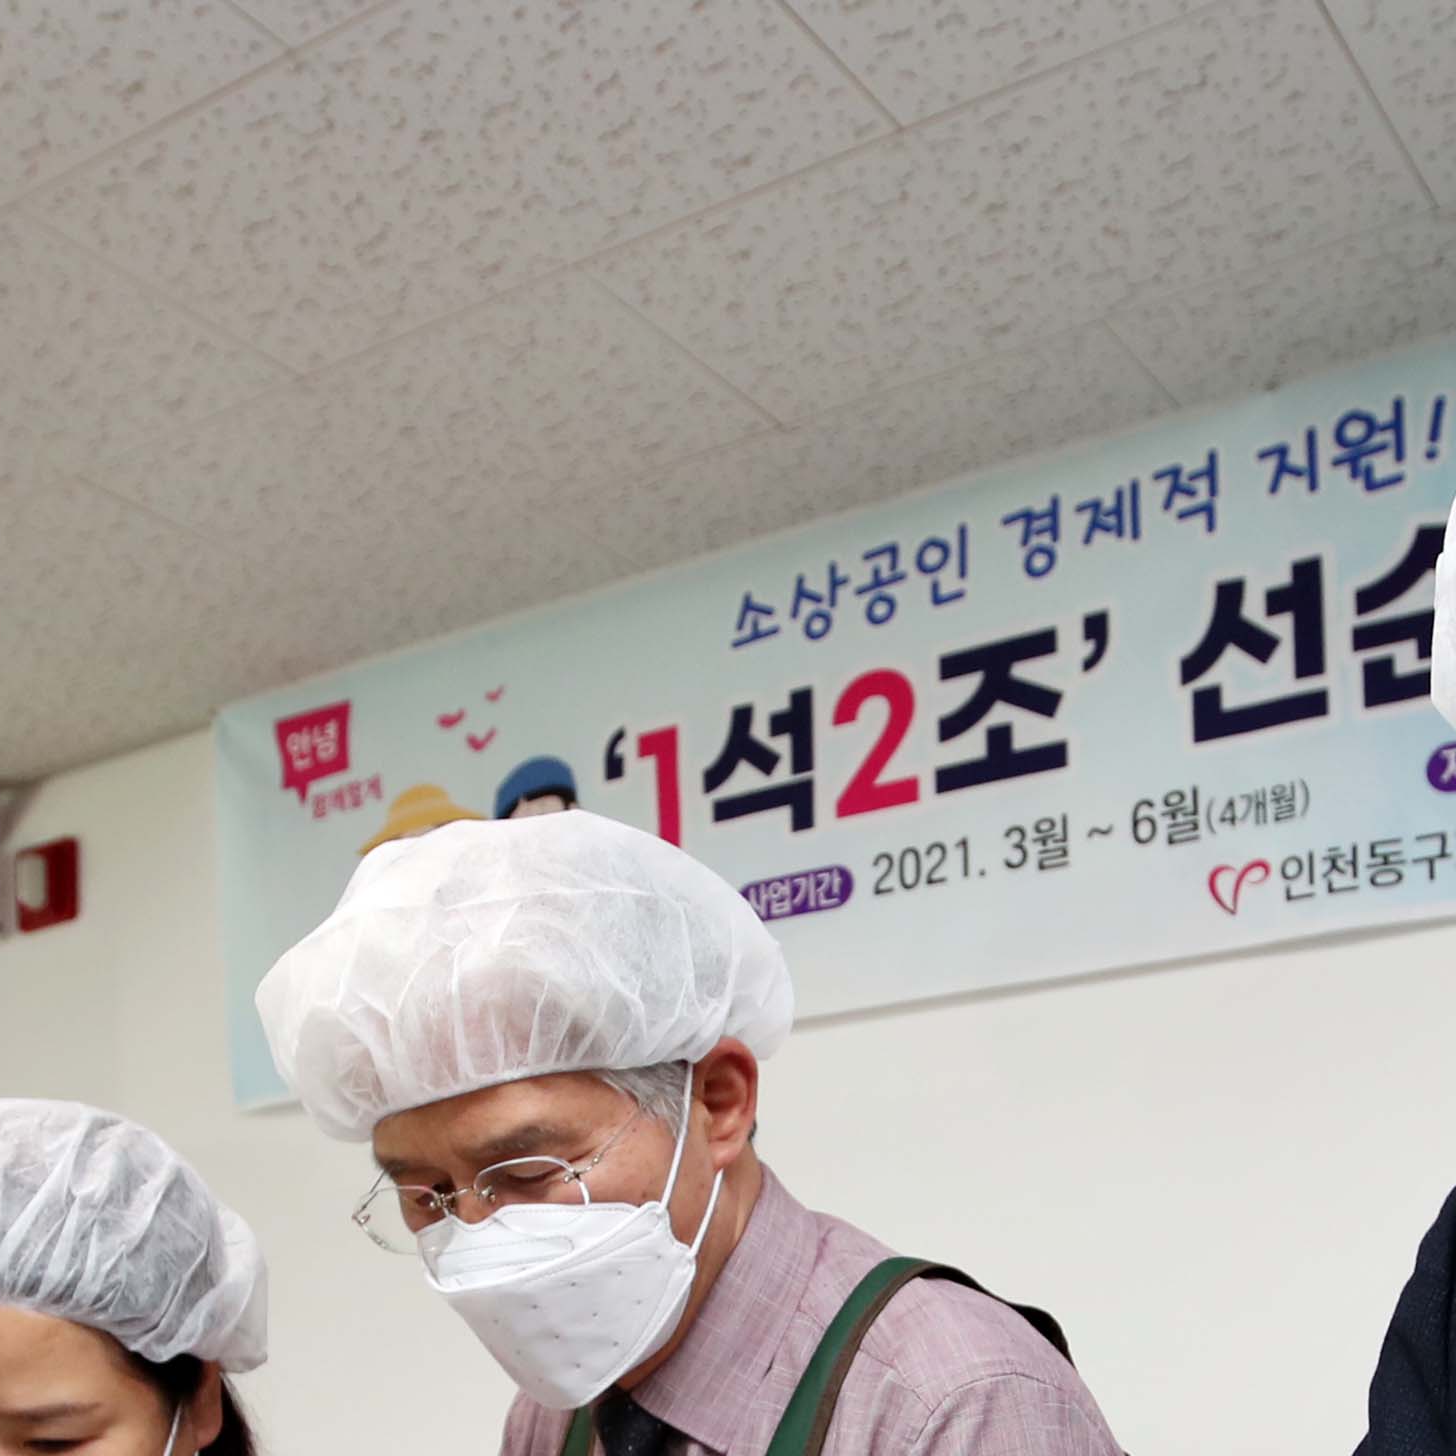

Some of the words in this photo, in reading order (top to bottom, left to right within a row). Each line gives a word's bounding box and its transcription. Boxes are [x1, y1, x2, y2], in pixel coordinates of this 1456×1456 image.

[731, 522, 968, 649] 소상공인
[1000, 449, 1221, 578] 경제적
[1255, 393, 1447, 499] 지원!
[746, 864, 843, 918] 사업기간
[872, 836, 987, 897] 2021.
[1002, 812, 1070, 872] 3월
